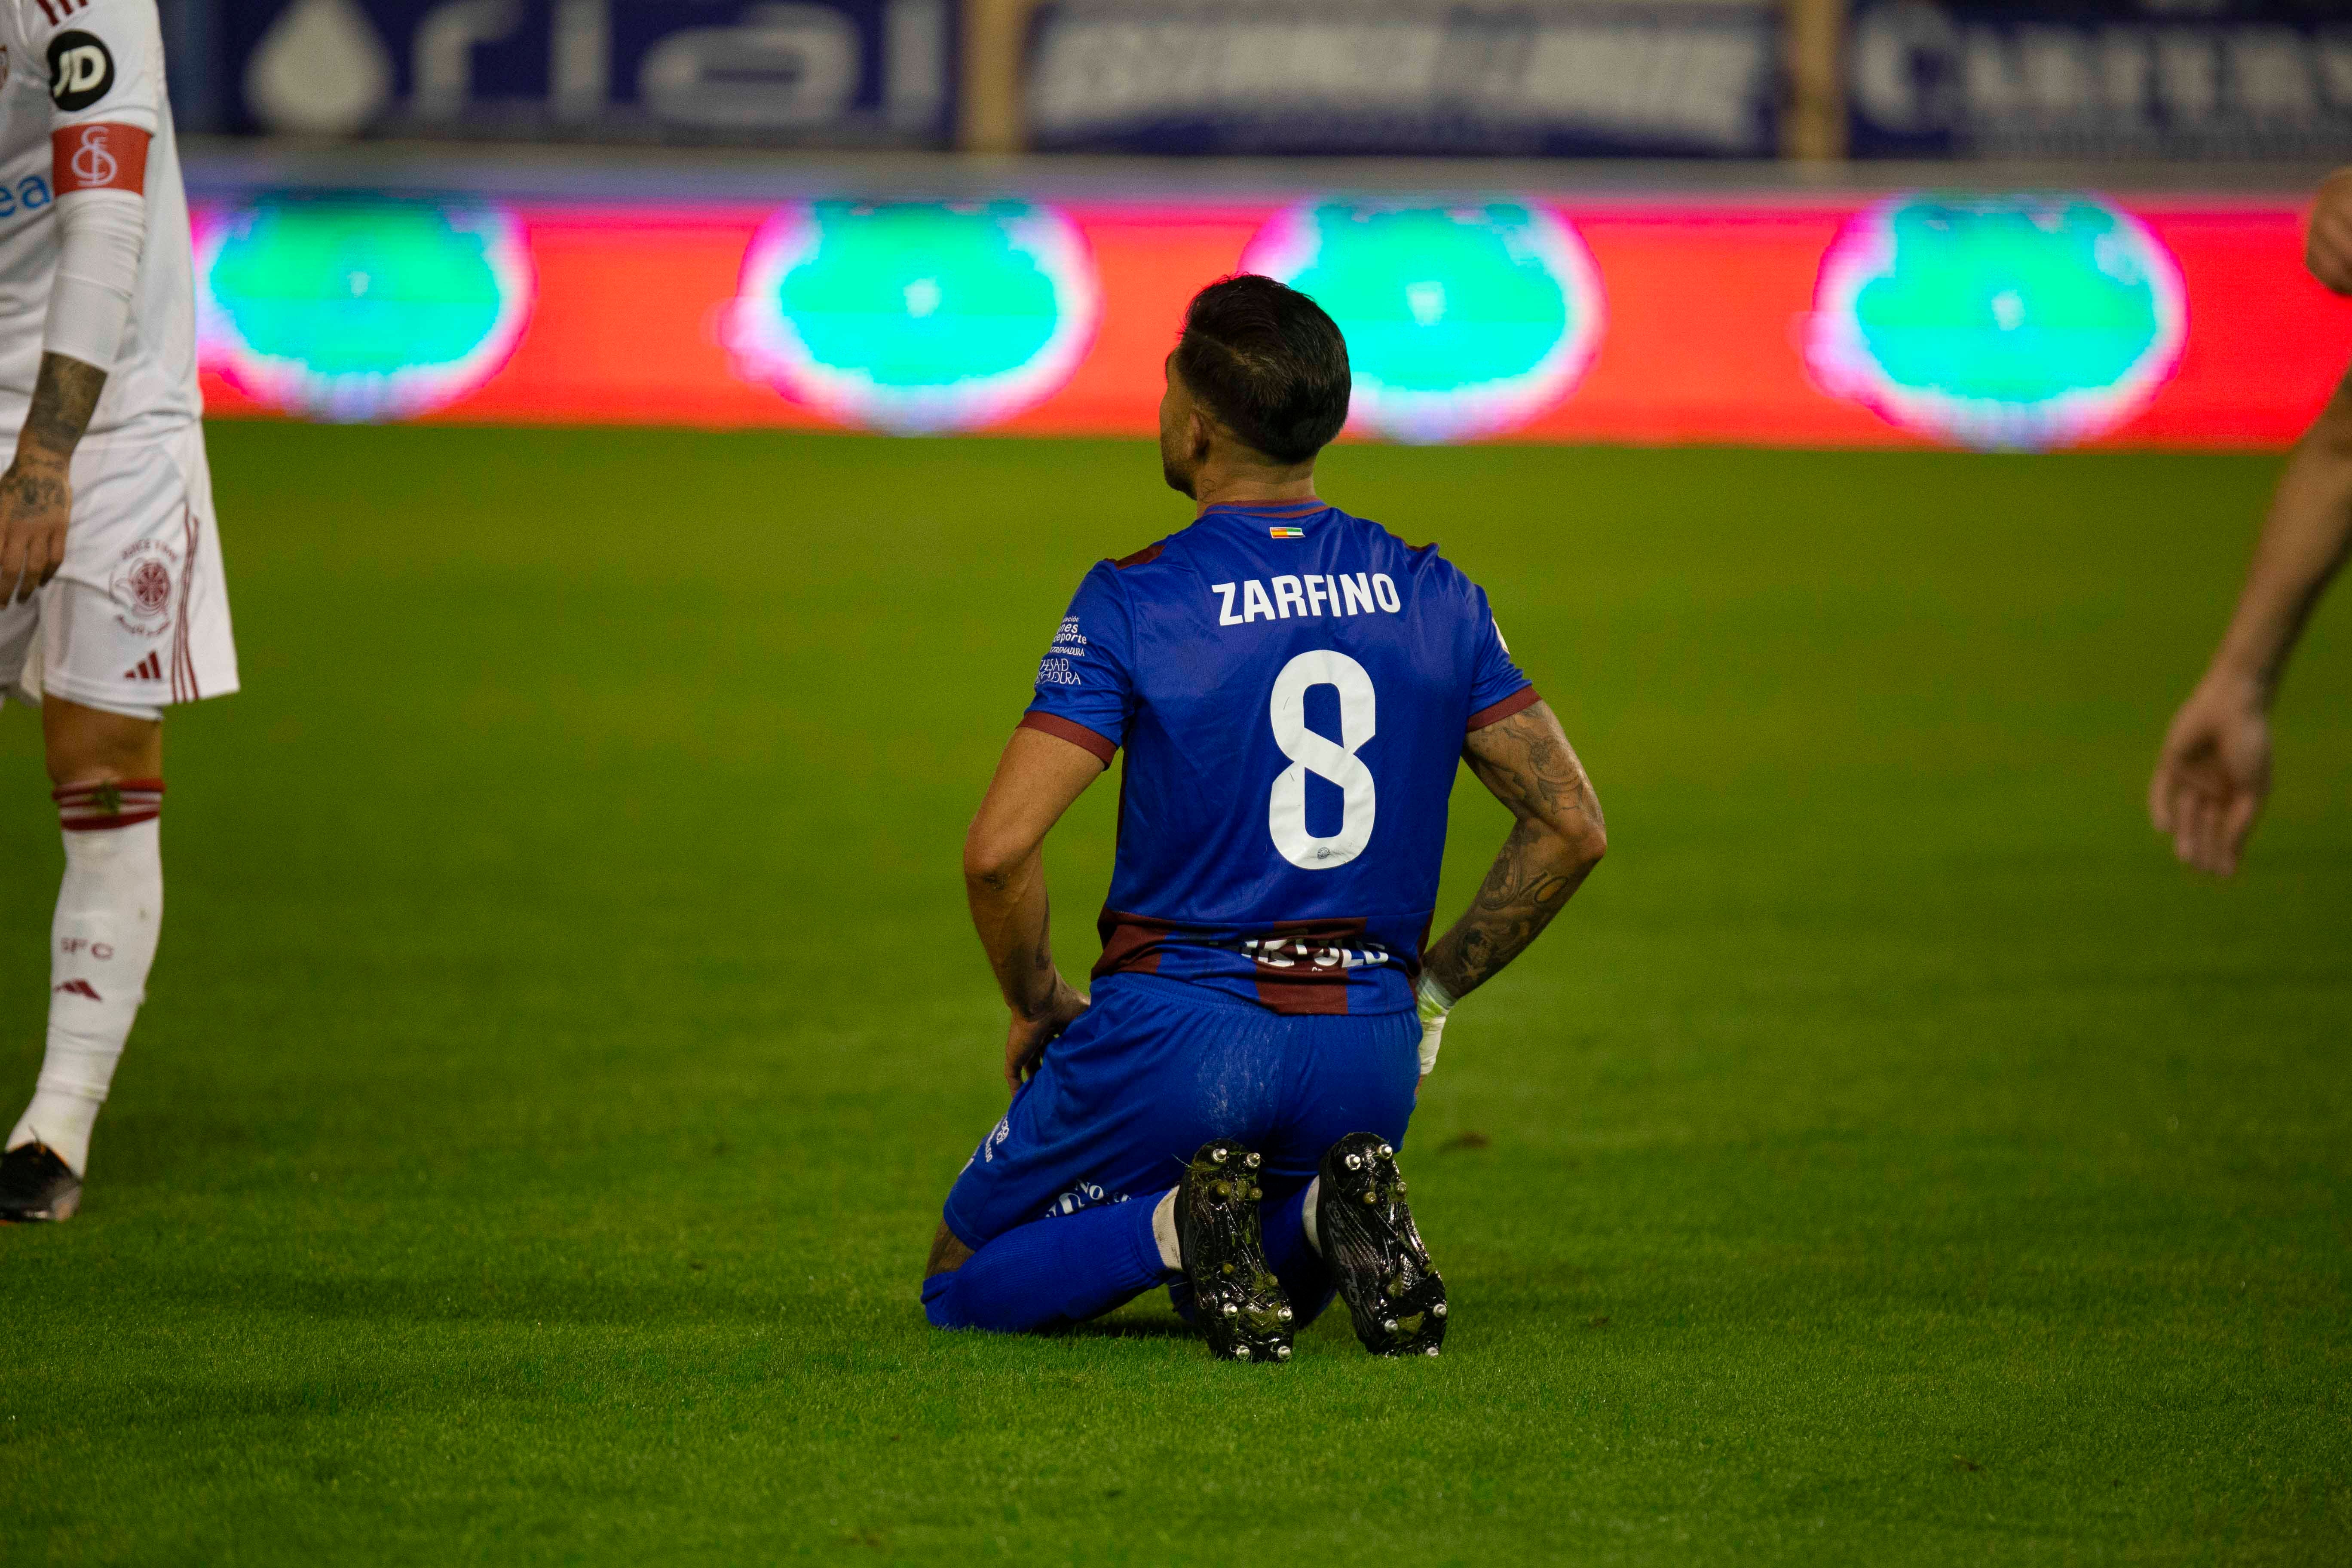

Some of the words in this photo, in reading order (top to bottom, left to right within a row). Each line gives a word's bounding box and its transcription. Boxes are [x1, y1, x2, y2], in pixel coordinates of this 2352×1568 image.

[53, 45, 107, 98] JD
[1212, 573, 1401, 626] ZARFINO
[1269, 649, 1375, 870] 8
